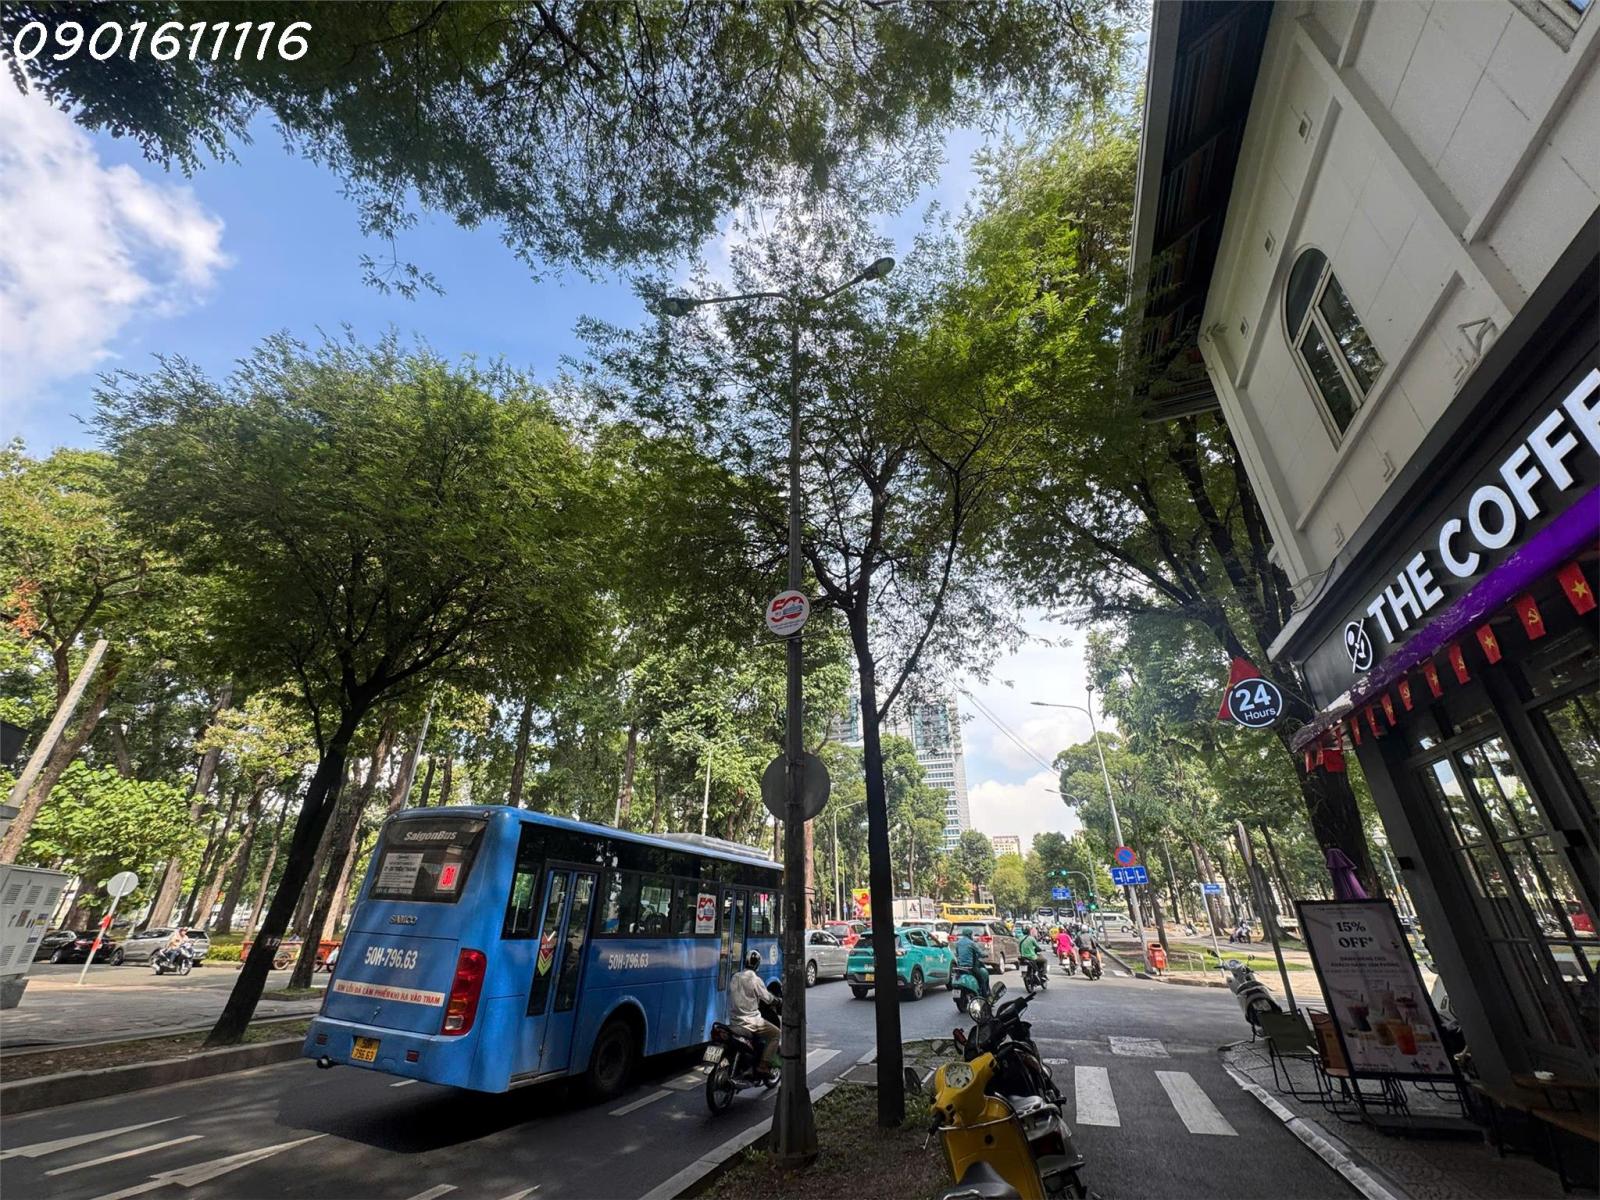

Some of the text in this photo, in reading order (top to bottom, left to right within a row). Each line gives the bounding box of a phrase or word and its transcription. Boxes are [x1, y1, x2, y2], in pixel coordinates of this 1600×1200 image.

[1367, 552, 1444, 643] THE
[1235, 684, 1272, 711] 24
[1244, 707, 1276, 721] Hours
[404, 831, 457, 841] SaigonBus
[1336, 921, 1367, 932] 15%
[364, 946, 418, 970] 50H-796.63
[607, 953, 649, 970] 50H-796.63
